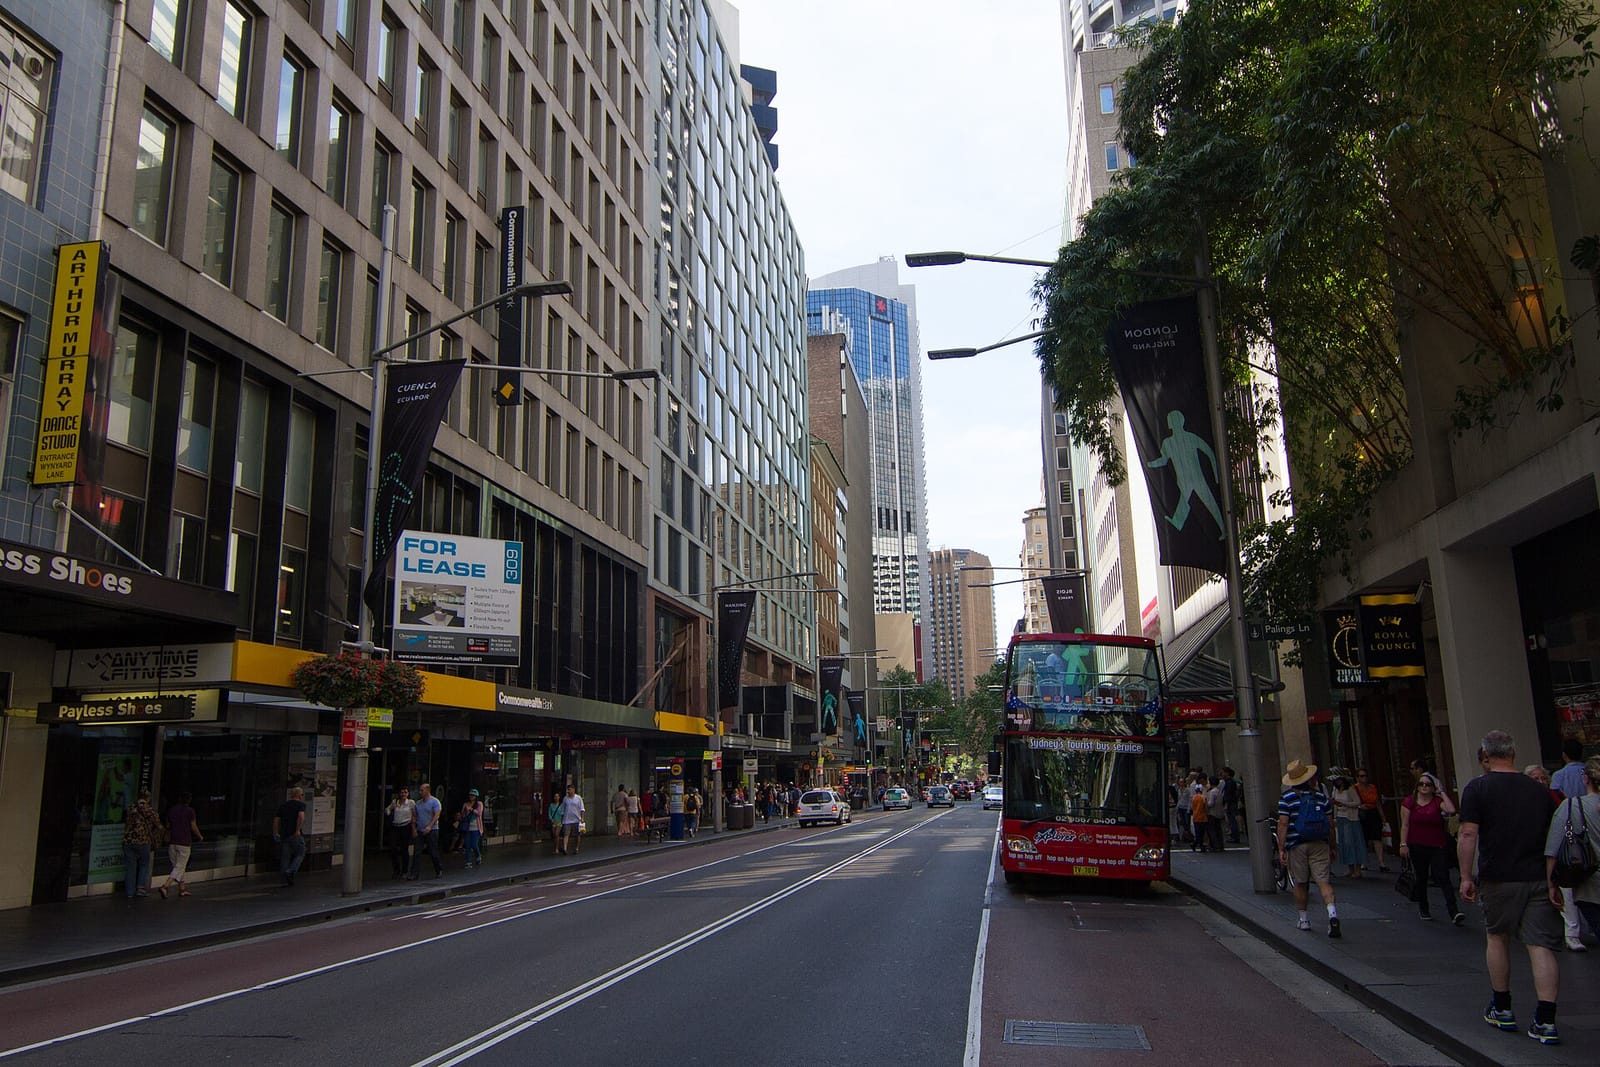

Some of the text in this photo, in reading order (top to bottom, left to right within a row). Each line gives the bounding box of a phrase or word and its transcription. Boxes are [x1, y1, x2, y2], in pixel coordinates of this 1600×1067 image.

[506, 210, 518, 309] Commonwealth Bk
[65, 250, 87, 327] ARTHUR
[57, 332, 79, 412] MURRAY
[397, 381, 437, 393] CUENCA
[397, 393, 430, 404] ECUADOR
[43, 415, 79, 433] DANCE
[41, 433, 77, 451] STUDIO
[40, 452, 75, 462] ENTRANCE
[40, 461, 73, 471] WYNYARD
[46, 470, 65, 479] LANE
[403, 537, 457, 556] FOR
[0, 548, 133, 595] ss Shoes
[403, 557, 486, 578] LEASE
[505, 549, 518, 580] 309
[1265, 624, 1310, 635] Palings Ln
[1374, 631, 1410, 640] ROYAL
[1370, 642, 1417, 652] LOUNGE
[111, 649, 199, 668] ANYTIME
[111, 666, 198, 681] FITNESS
[498, 691, 543, 709] Commonwealth
[58, 704, 113, 721] Payless
[117, 702, 163, 716] Shoes
[1030, 738, 1142, 752] Sydney's tourist bus service
[1047, 854, 1056, 862] hop
[1065, 855, 1075, 863] hop
[1076, 856, 1084, 864] off
[1088, 857, 1098, 865] hop
[1107, 858, 1117, 866] hop
[1130, 859, 1139, 867] hop
